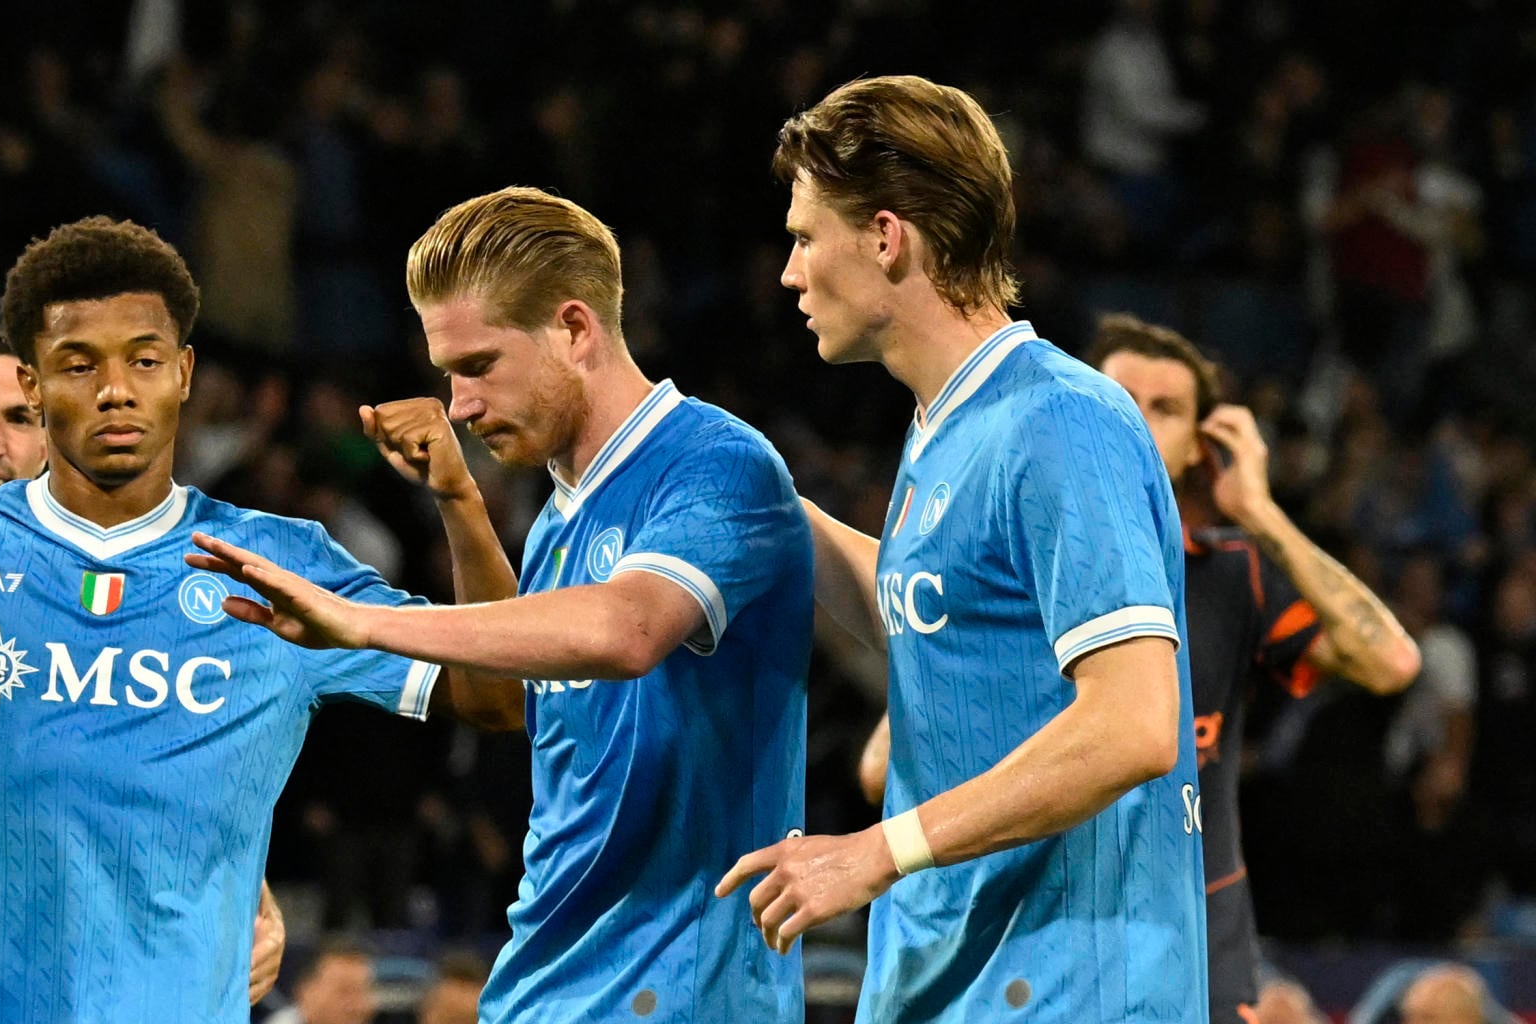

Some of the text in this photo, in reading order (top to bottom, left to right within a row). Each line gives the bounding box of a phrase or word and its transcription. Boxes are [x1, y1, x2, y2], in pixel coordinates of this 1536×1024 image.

[928, 498, 946, 524] N
[600, 541, 617, 569] N
[192, 587, 215, 613] N
[40, 641, 232, 715] MSC
